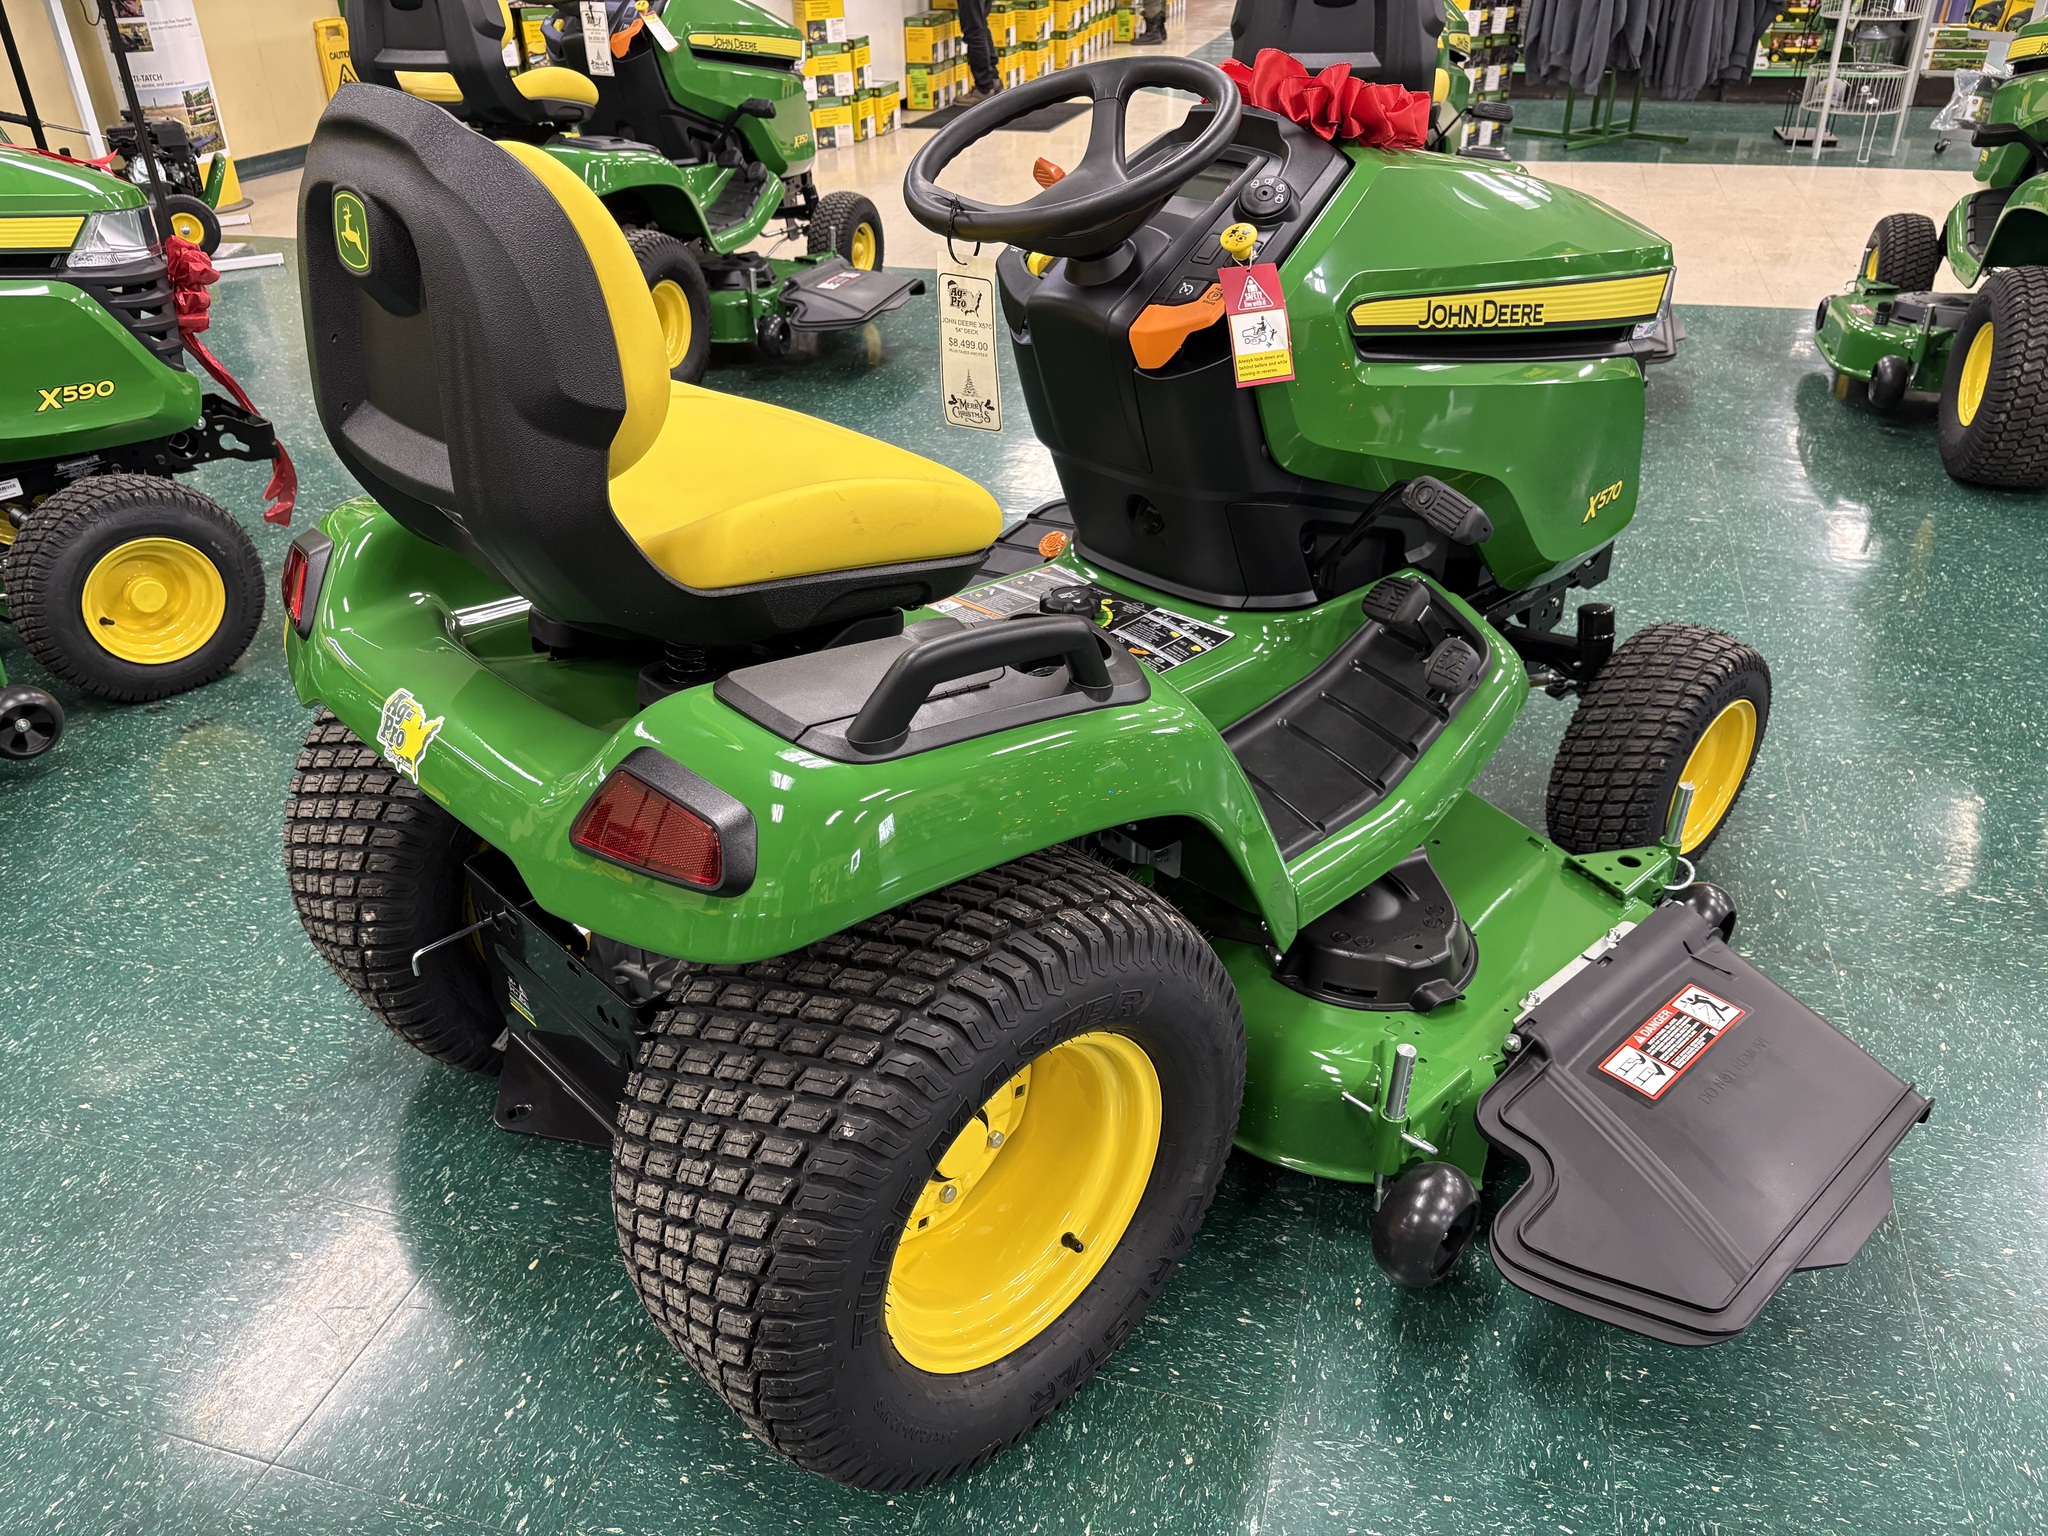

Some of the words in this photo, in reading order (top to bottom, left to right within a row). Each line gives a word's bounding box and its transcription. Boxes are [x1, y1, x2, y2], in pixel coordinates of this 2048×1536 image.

[712, 36, 733, 50] JOHN
[733, 38, 758, 52] DEERE
[329, 50, 350, 60] CAUTIO
[950, 288, 966, 299] Ag-
[950, 296, 967, 308] Pro
[1418, 300, 1478, 326] JOHN
[1482, 299, 1544, 325] DEERE
[942, 317, 957, 325] JOHN
[957, 319, 977, 328] DEERE
[964, 327, 979, 335] DECK
[948, 336, 989, 351] $8,499.00
[1238, 357, 1254, 365] Always
[1240, 370, 1256, 378] moving
[34, 379, 115, 413] X590
[957, 398, 984, 413] MERRY
[952, 405, 991, 424] CHRISTMAS
[1581, 479, 1623, 525] X570
[380, 714, 406, 749] Pro
[1641, 1009, 1674, 1037] DANGER
